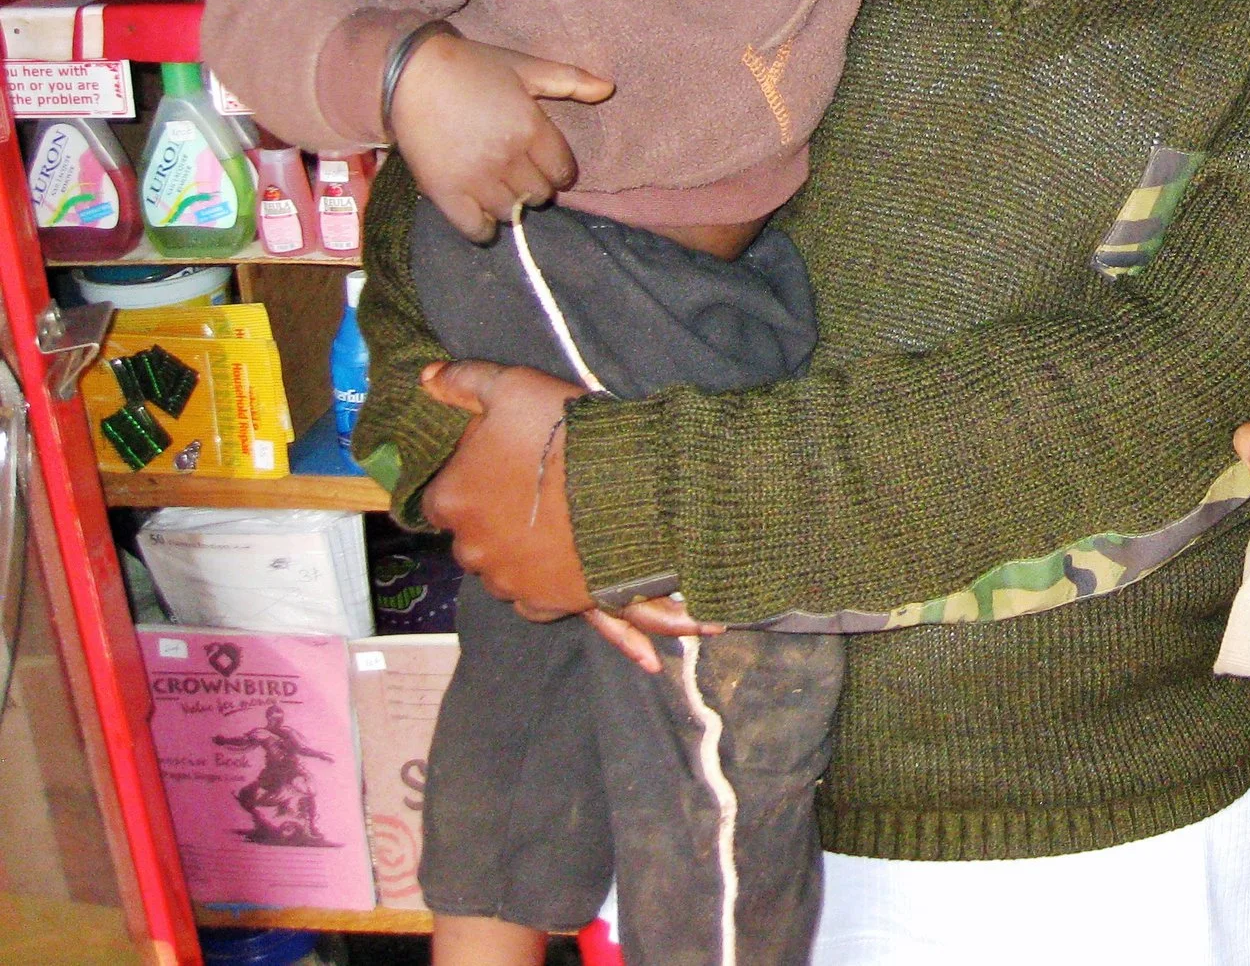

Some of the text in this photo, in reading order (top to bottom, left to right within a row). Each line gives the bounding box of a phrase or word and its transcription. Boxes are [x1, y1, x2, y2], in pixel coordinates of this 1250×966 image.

[22, 66, 54, 77] here
[58, 65, 88, 76] with
[29, 82, 42, 91] or
[48, 82, 73, 93] you
[77, 81, 100, 91] are
[11, 93, 100, 107] the problem?
[31, 130, 68, 206] LURON
[231, 362, 249, 420] Household
[153, 677, 299, 696] CROWNBIRD
